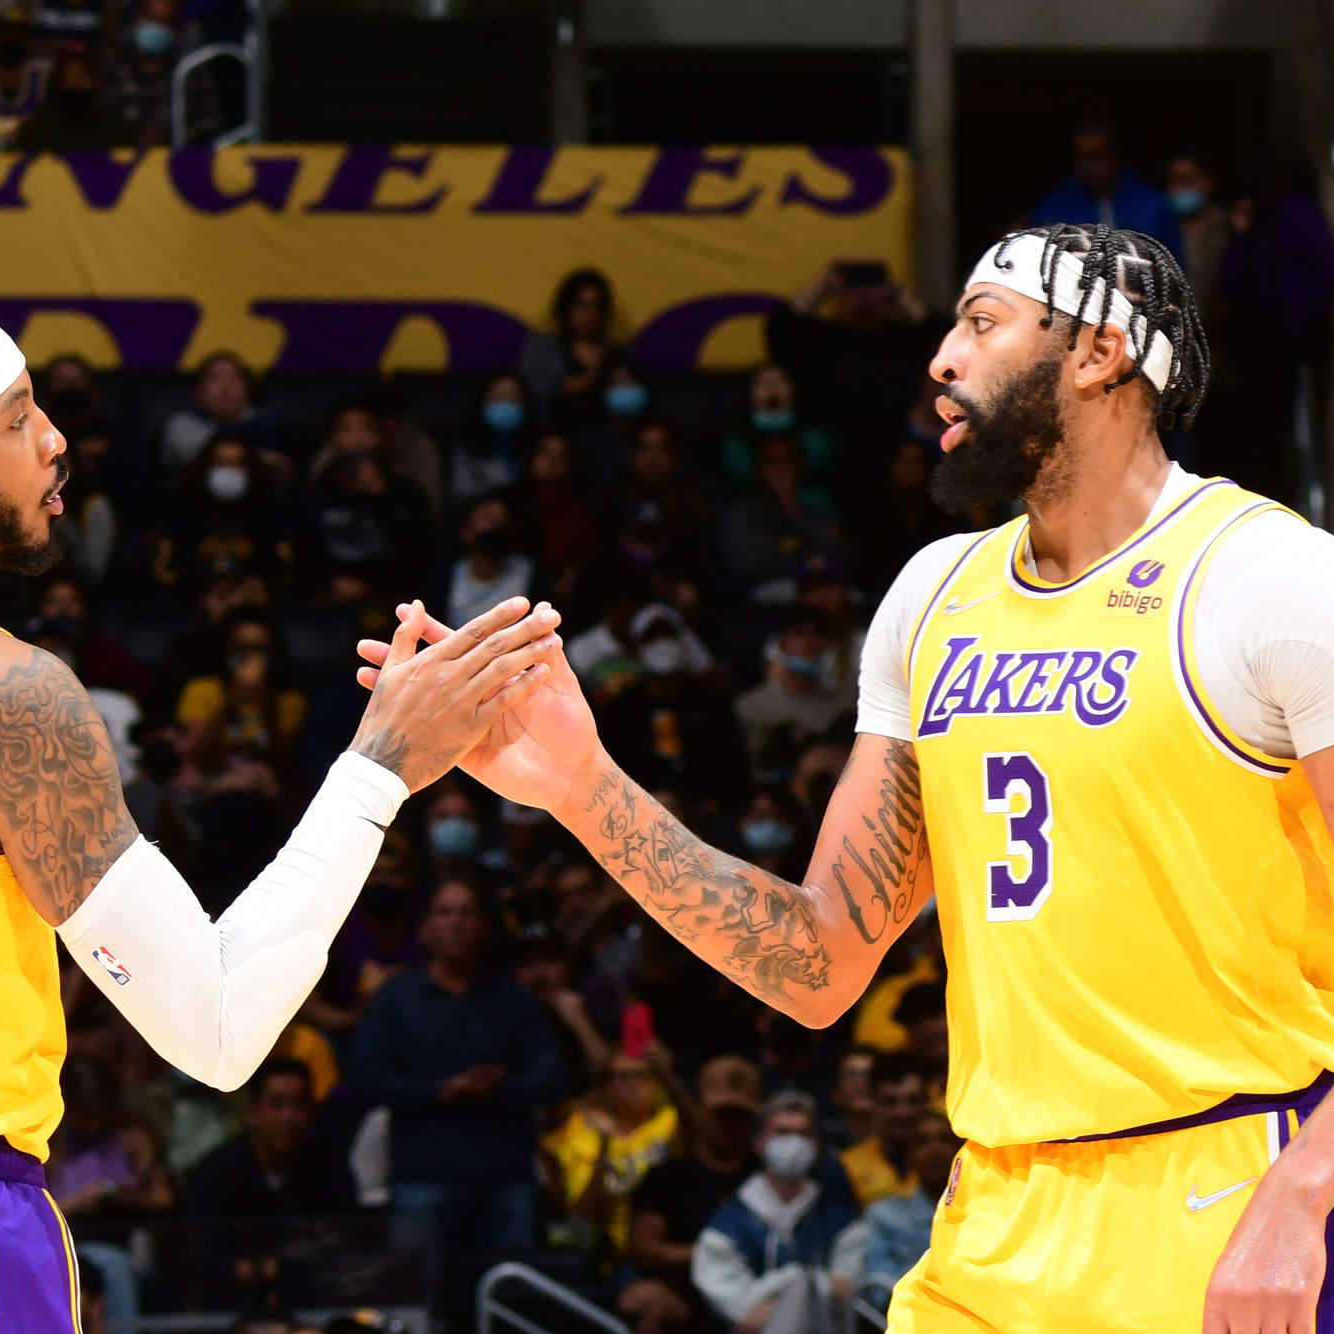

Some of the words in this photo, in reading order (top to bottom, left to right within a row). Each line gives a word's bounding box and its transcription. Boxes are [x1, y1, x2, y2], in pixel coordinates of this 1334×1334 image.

[1106, 588, 1163, 616] bibigo
[916, 633, 1141, 740] LAKERS
[982, 751, 1054, 923] 3
